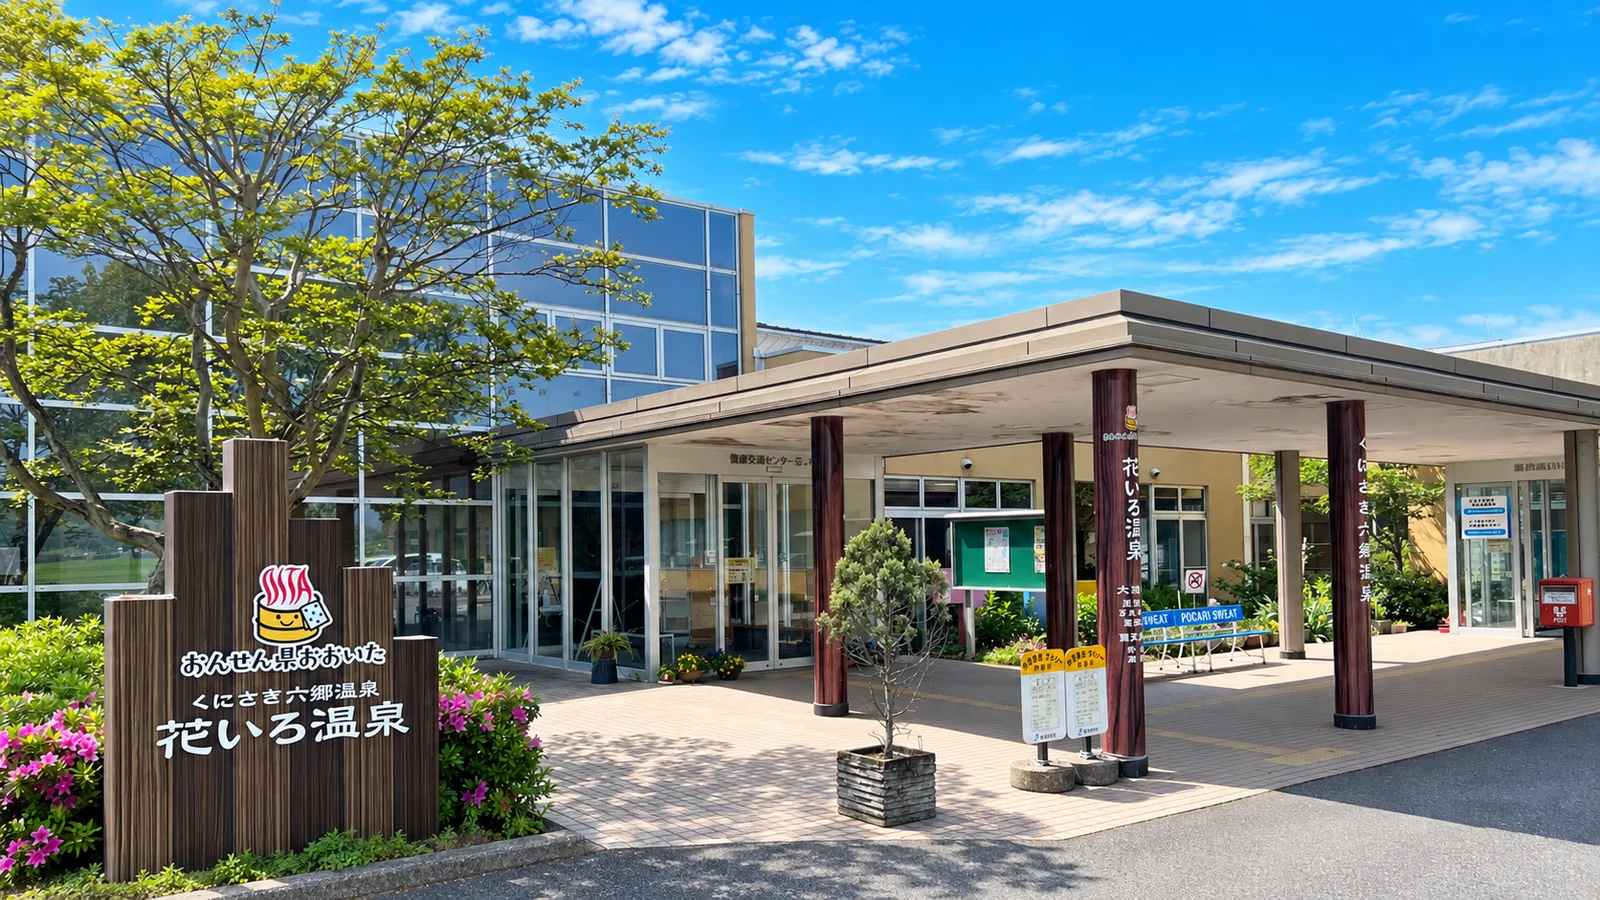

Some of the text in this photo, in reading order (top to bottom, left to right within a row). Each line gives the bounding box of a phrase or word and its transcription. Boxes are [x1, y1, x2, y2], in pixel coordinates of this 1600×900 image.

[1122, 457, 1141, 561] 花いろ温泉
[1181, 608, 1238, 623] POCARI SWEAT
[180, 642, 386, 677] おんせん県おおいた
[192, 680, 380, 710] くにさき六郷温泉
[156, 700, 410, 759] 花いろ温泉
